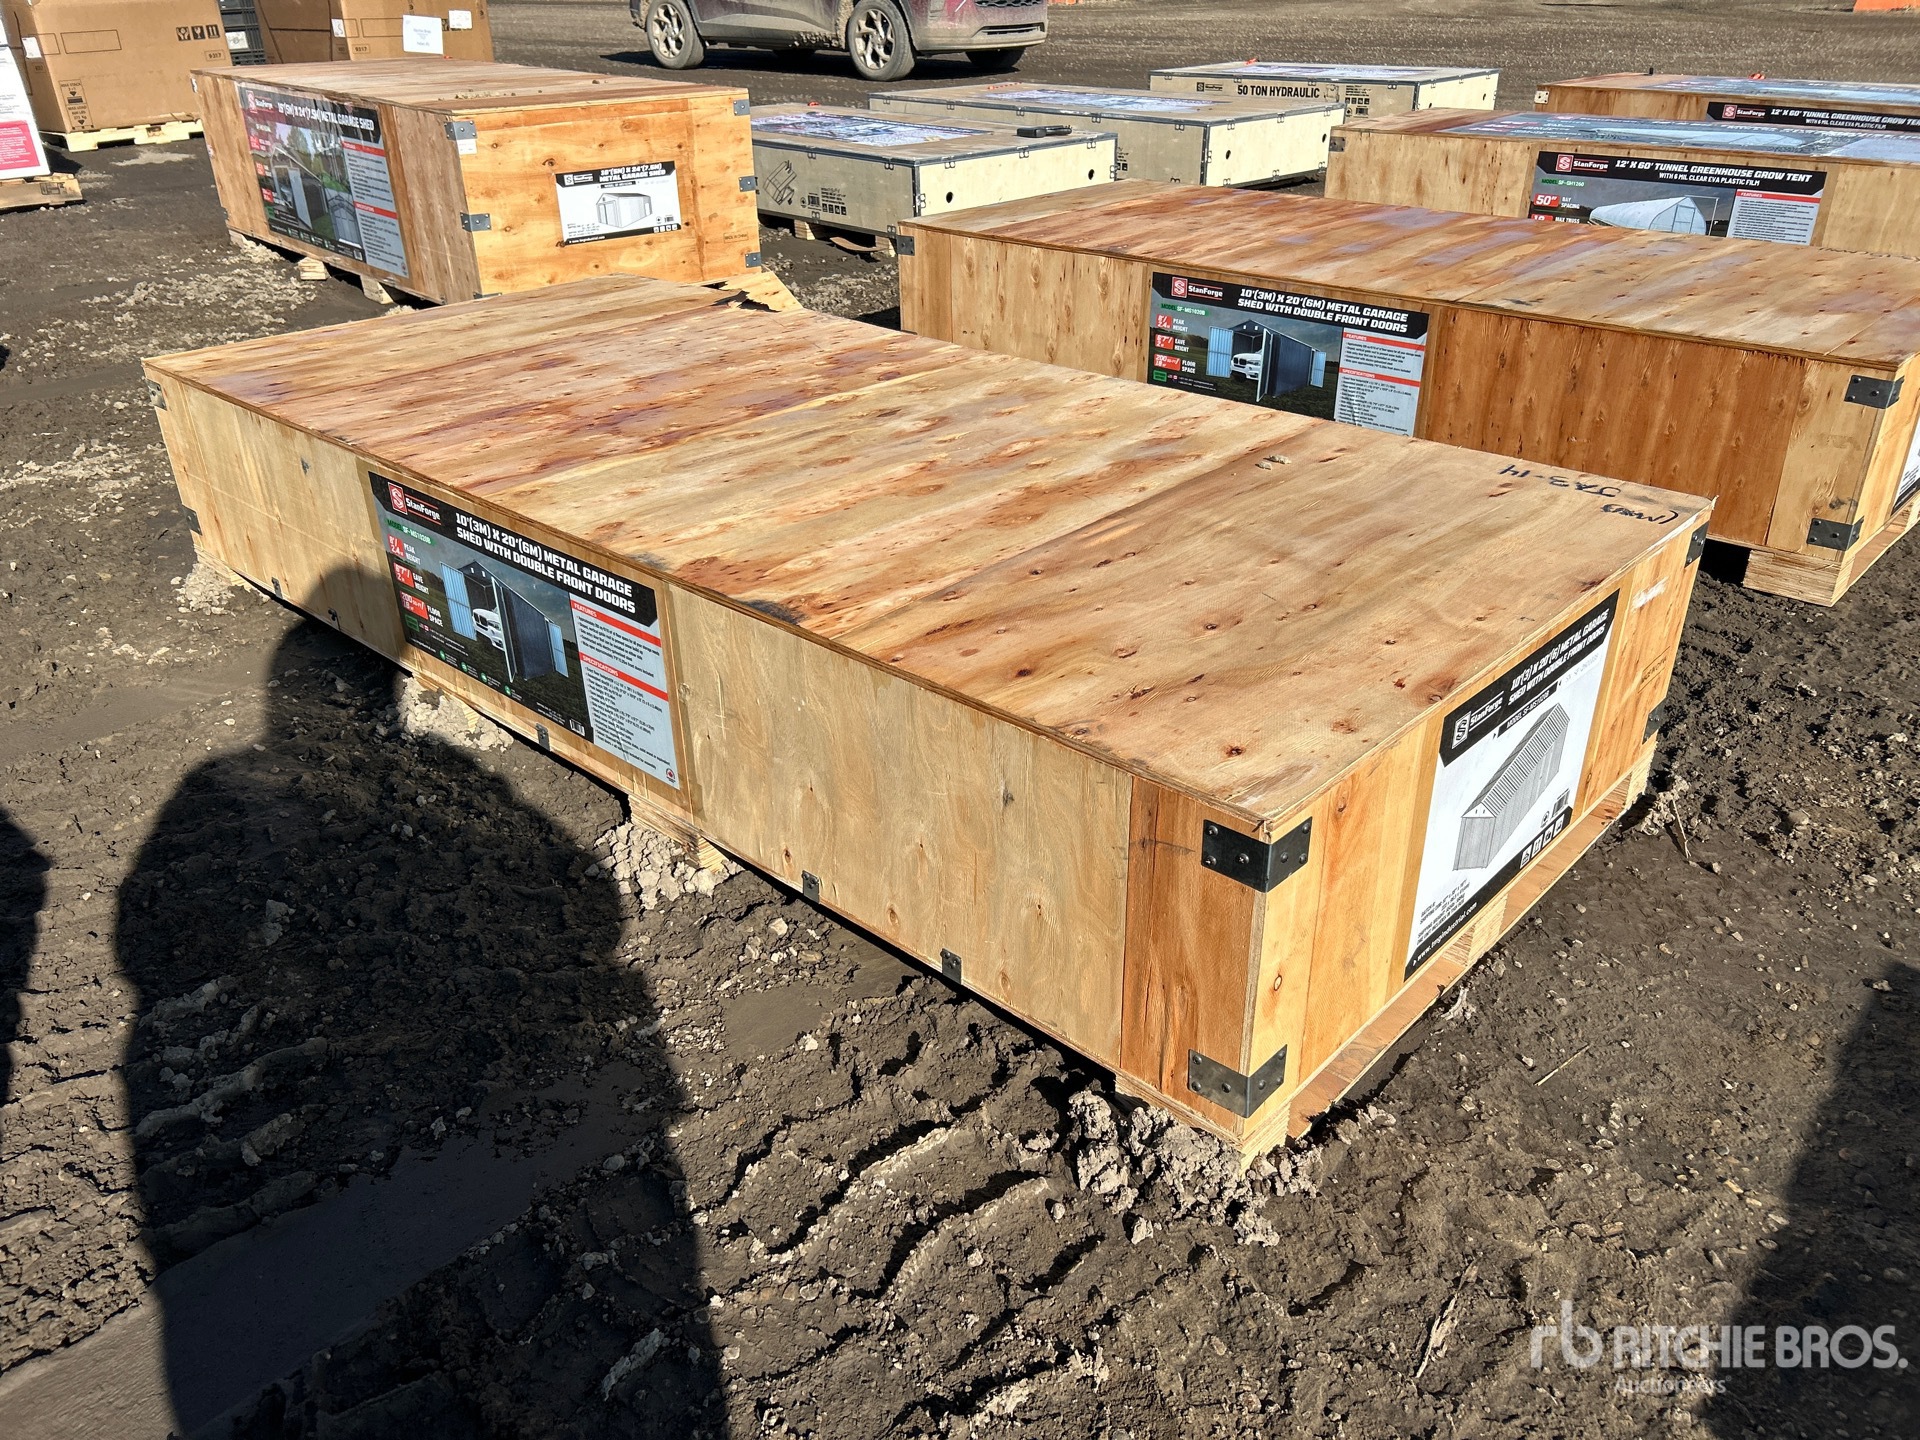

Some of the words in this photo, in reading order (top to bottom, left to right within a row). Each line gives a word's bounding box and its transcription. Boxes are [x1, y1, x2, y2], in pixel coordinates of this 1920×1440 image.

[1237, 85, 1248, 96] 50
[1250, 85, 1267, 97] TON
[1269, 86, 1320, 99] HYDRAULIC
[1736, 109, 1766, 117] StanForge
[1802, 111, 1831, 120] TUNNEL
[1830, 113, 1882, 124] GREENHOUSE
[1881, 116, 1907, 125] GROW
[321, 111, 338, 124] METAL
[338, 113, 359, 128] GARAGE
[360, 117, 375, 131] SHED
[1854, 122, 1875, 130] PLASTIC
[1572, 160, 1609, 171] StanForge
[1614, 158, 1630, 169] 12'
[1630, 160, 1638, 169] X
[1638, 161, 1654, 172] 60'
[1654, 162, 1690, 174] TUNNEL
[1690, 164, 1753, 180] GREENHOUSE
[1753, 169, 1786, 182] GROW
[1786, 171, 1813, 183] TENT
[599, 174, 622, 182] METAL
[621, 172, 649, 180] GARAGE
[648, 169, 666, 177] SHED
[1658, 171, 1673, 180] WITH
[1678, 174, 1688, 182] MIL
[1688, 174, 1707, 184] CLEAR
[1707, 175, 1720, 185] EVA
[1719, 176, 1745, 187] PLASTIC
[1745, 178, 1761, 188] FILM
[1187, 285, 1224, 299] StanForge
[1240, 287, 1277, 304] 10'(3M)
[1277, 294, 1286, 304] X
[1286, 296, 1326, 313] 20'(6M)
[1326, 301, 1361, 316] METAL
[1362, 306, 1410, 324] GARAGE
[1172, 317, 1185, 326] PEAK
[1238, 298, 1264, 313] SHED
[1264, 302, 1293, 317] WITH
[1292, 306, 1335, 322] DOUBLE
[1334, 312, 1371, 328] FRONT
[1370, 318, 1409, 335] DOORS
[1172, 324, 1189, 333] HEIGHT
[1174, 337, 1187, 346] EAVE
[1345, 333, 1368, 342] FEATURES
[1174, 344, 1190, 353] HEIGHT
[1181, 359, 1197, 368] FLOOR
[1181, 365, 1196, 374] SPACE
[405, 496, 442, 522] StanForge
[403, 543, 416, 557] PEAK
[455, 512, 493, 537] 10'(3M)
[491, 528, 501, 543] X
[501, 530, 543, 564] 20'(6M)
[543, 550, 582, 578] METAL
[582, 563, 633, 600] GARAGE
[456, 526, 483, 550] SHED
[483, 538, 512, 563] WITH
[512, 550, 555, 580] DOUBLE
[555, 569, 594, 599] FRONT
[594, 588, 636, 617] DOORS
[426, 605, 442, 621] FLOOR
[573, 602, 599, 618] FEATURES
[1559, 628, 1583, 655] METAL
[1581, 607, 1611, 638] GARAGE
[582, 653, 620, 678] SPECIFICATIONS
[1507, 683, 1528, 707] SHED
[1525, 669, 1546, 692] WITH
[1543, 652, 1569, 677] DOUBLE
[1566, 637, 1588, 661] FRONT
[1585, 622, 1607, 647] DOORS
[1469, 696, 1504, 727] StanForge
